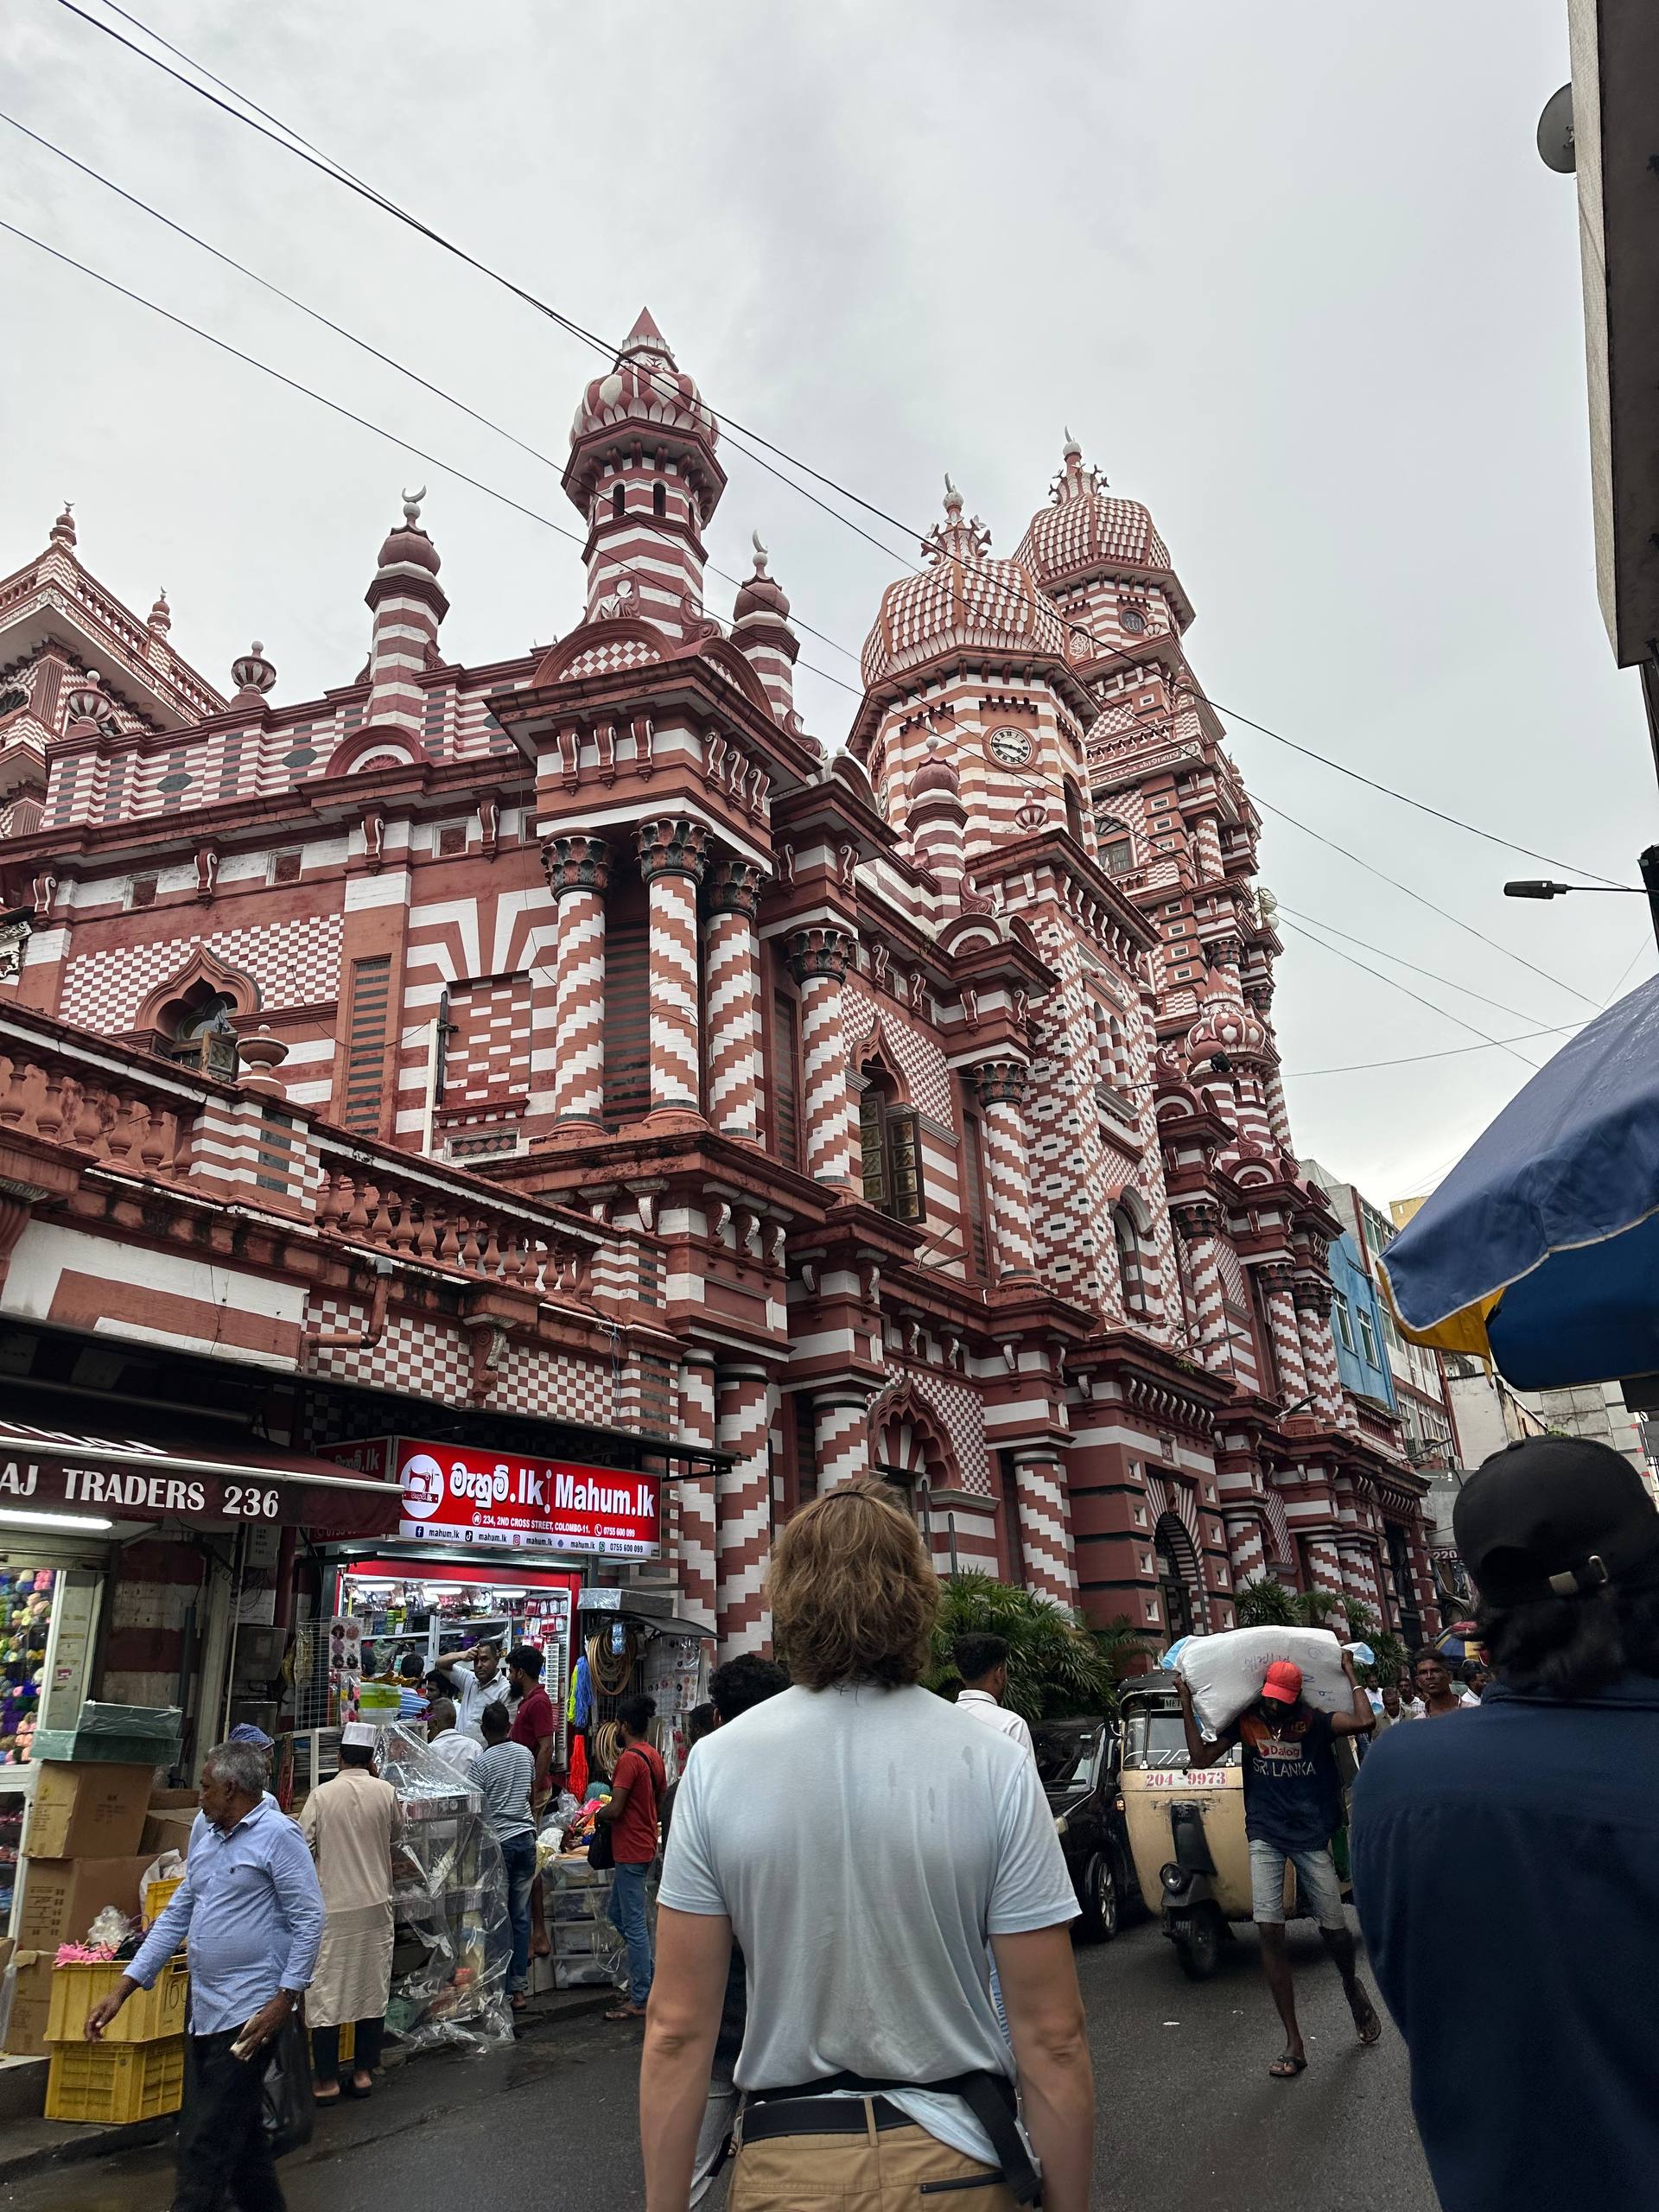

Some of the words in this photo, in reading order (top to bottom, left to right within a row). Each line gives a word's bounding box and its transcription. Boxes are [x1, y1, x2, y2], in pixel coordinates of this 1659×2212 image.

[62, 1468, 206, 1511] TRADERS
[222, 1485, 279, 1518] 236
[555, 1473, 655, 1518] Mahum.lk
[482, 1515, 496, 1527] 234,
[497, 1516, 510, 1527] 2ND
[510, 1517, 531, 1529] CROSS
[531, 1519, 554, 1532] STREET,
[429, 1529, 460, 1539] mahum.lk
[603, 1526, 616, 1536] 0755
[478, 1533, 507, 1542] mahum.lk
[525, 1536, 553, 1547] mahum.lk
[570, 1540, 595, 1550] mahum.lk
[609, 1542, 623, 1552] 0755
[623, 1543, 633, 1553] 600
[633, 1544, 644, 1554] 099
[1272, 1760, 1317, 1777] LANKA
